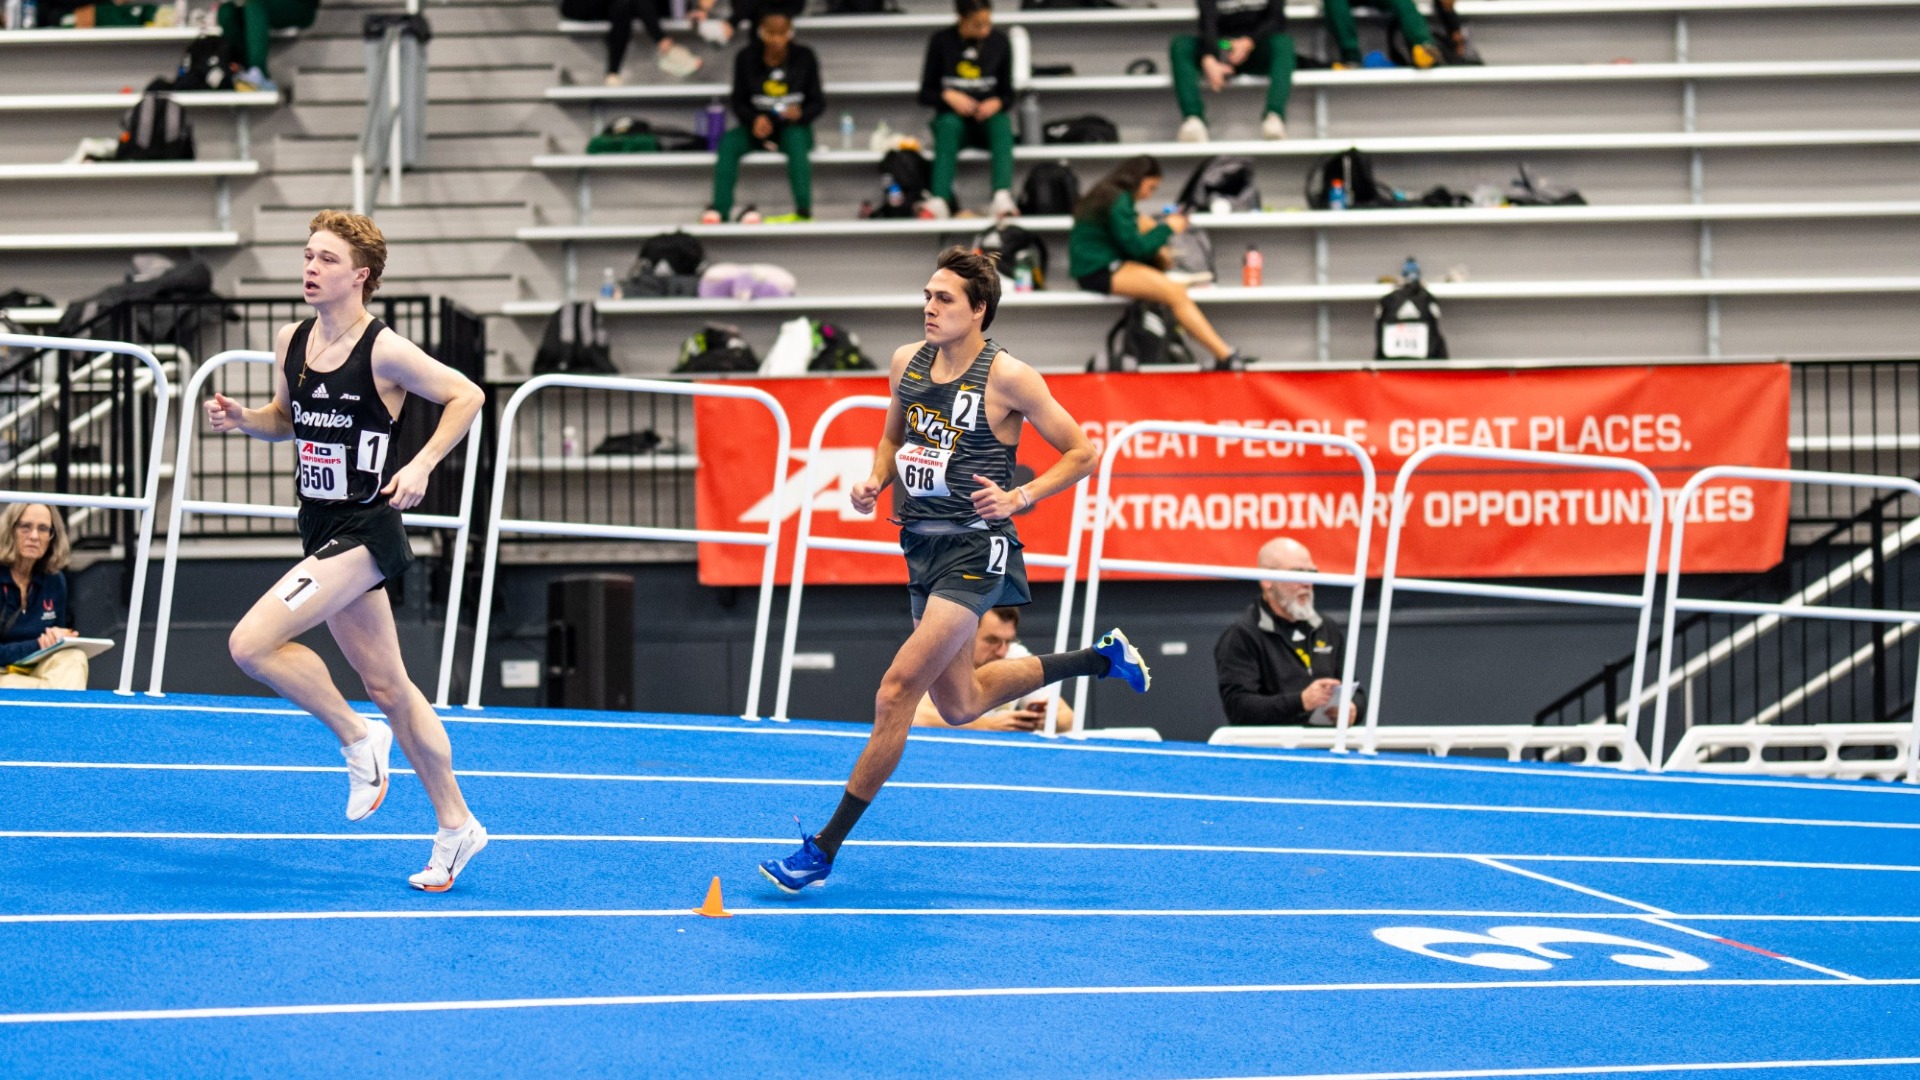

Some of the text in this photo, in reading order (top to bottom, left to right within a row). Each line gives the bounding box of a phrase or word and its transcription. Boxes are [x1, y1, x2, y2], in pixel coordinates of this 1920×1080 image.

[292, 400, 354, 428] Bonnies
[912, 405, 958, 450] VCU
[954, 393, 973, 429] 2
[367, 435, 381, 471] 1
[1216, 418, 1377, 458] PEOPLE.
[1388, 417, 1519, 456] GREAT
[1528, 413, 1692, 453] PLACES.
[302, 463, 335, 491] 550
[898, 454, 944, 468] CHAMPIONSHIPS
[905, 464, 935, 491] 618
[1082, 486, 1755, 531] EXTRAORDINARY OPPORTUNITIES
[990, 538, 1005, 573] 2
[284, 577, 313, 603] 1
[1372, 925, 1710, 972] 3
